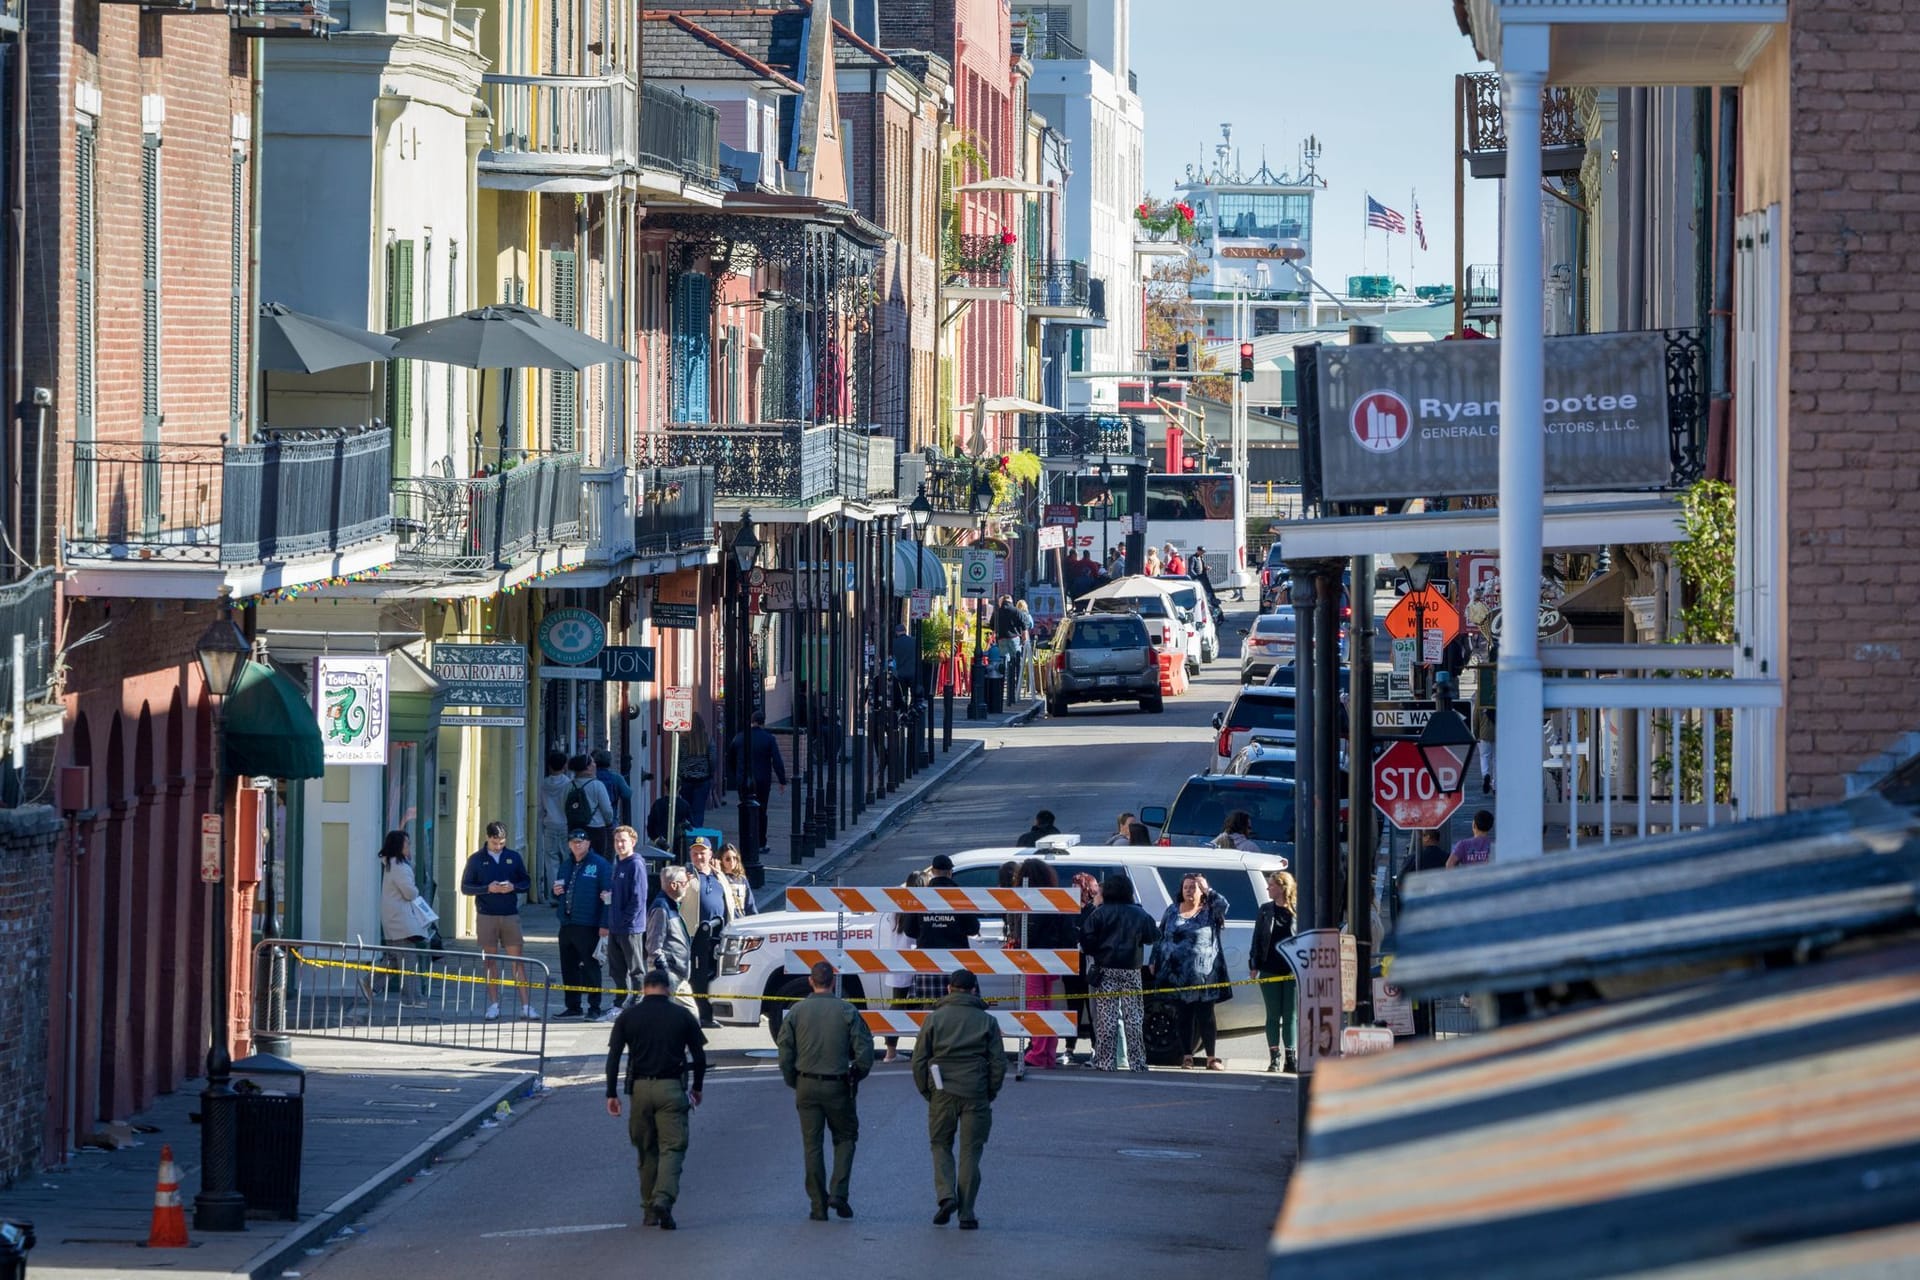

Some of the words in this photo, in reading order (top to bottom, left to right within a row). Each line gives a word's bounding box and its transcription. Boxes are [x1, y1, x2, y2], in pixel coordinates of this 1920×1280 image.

[1419, 398, 1500, 422] Ryan
[1543, 393, 1638, 414] ootee
[1421, 426, 1487, 439] GENERAL
[1602, 418, 1640, 432] L.L.C.
[1408, 602, 1439, 611] RAD
[1407, 618, 1439, 628] WRK
[435, 665, 469, 680] ROUX
[472, 665, 524, 680] ROYALE
[1375, 712, 1404, 725] ONE
[1410, 712, 1433, 725] WA
[1379, 767, 1458, 801] STOP
[769, 932, 809, 943] STATE
[812, 929, 873, 941] TROOPER
[1296, 948, 1337, 969] SPEED
[1307, 977, 1334, 998] LIMIT
[1307, 1006, 1333, 1057] 15
